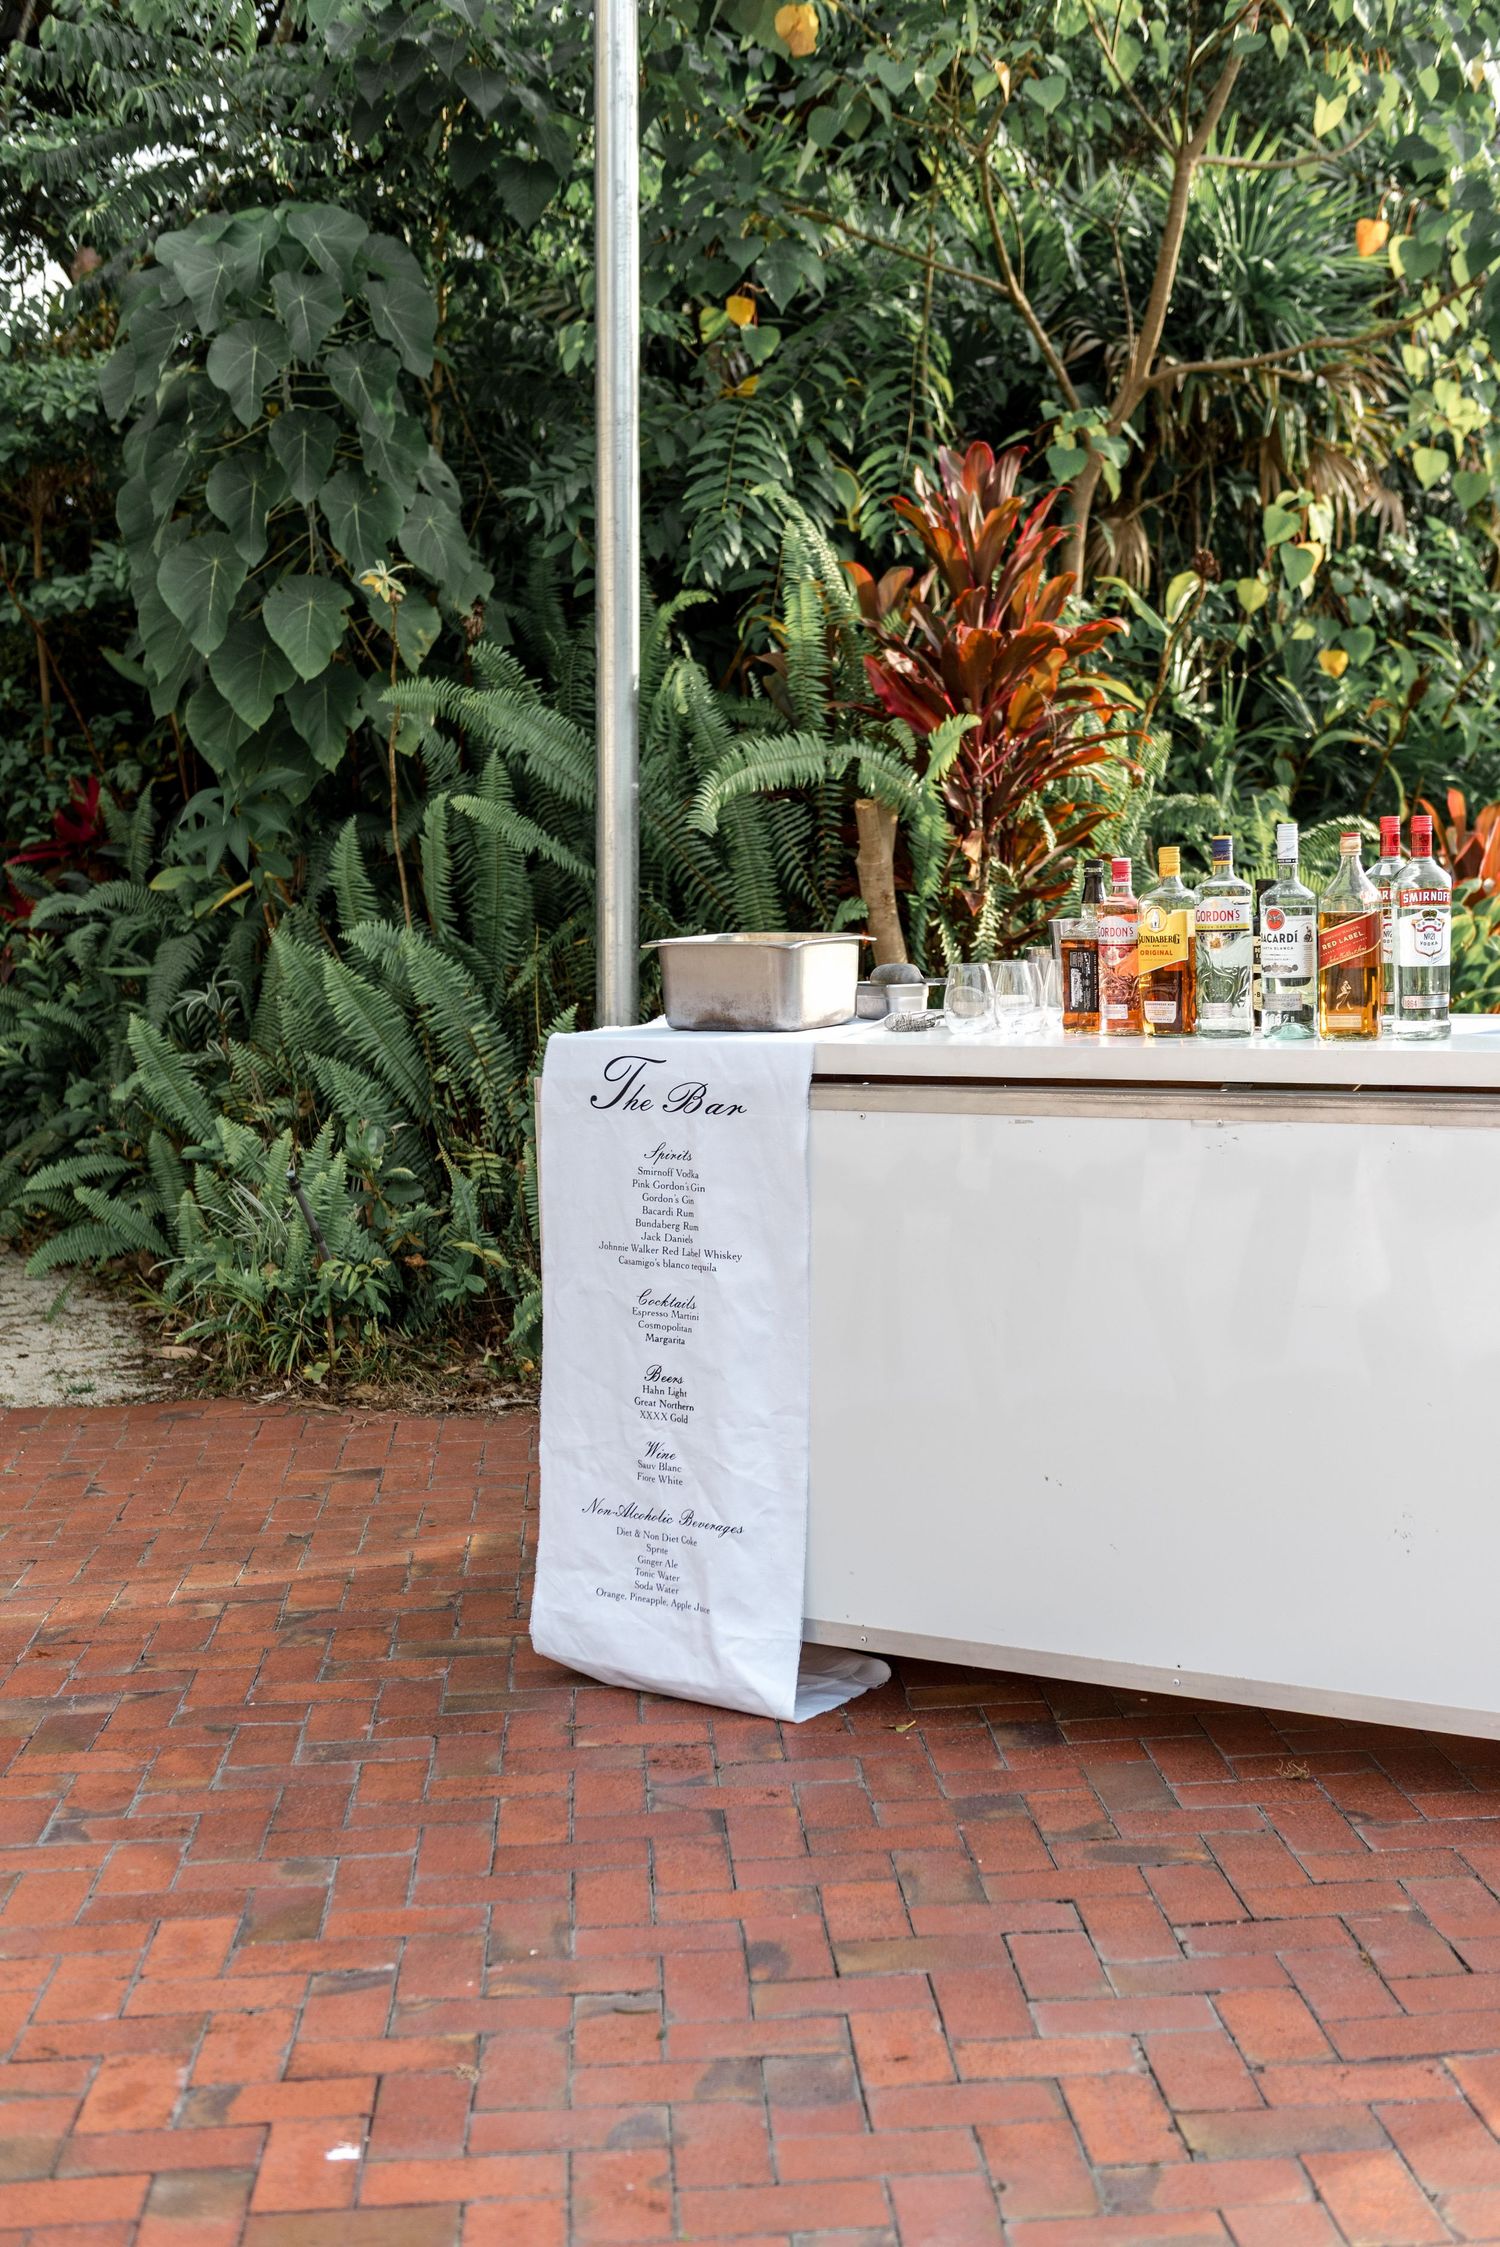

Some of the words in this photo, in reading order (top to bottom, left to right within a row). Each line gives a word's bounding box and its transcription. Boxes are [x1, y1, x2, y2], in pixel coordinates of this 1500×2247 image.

[1195, 909, 1240, 923] GORDON'S
[1322, 940, 1337, 950] RED
[1338, 931, 1364, 944] LABEL
[590, 1055, 667, 1111] The
[663, 1082, 747, 1116] Bar
[644, 1142, 693, 1165] Spirits
[637, 1167, 675, 1177] Smirnoff
[676, 1169, 699, 1179] Vodka
[632, 1180, 650, 1189] Pink
[652, 1180, 690, 1191] Gordon's
[691, 1183, 706, 1193] Gin
[642, 1193, 679, 1204] Gordon's
[681, 1195, 694, 1205] Gin
[642, 1206, 674, 1217] Bacardi
[676, 1208, 694, 1218] Rum
[635, 1219, 680, 1232] Bundaberg
[683, 1221, 699, 1232] Rum
[641, 1232, 661, 1242] Jack
[664, 1234, 694, 1244] Daniels
[598, 1241, 629, 1252] Johnnie
[631, 1244, 659, 1255] Walker
[662, 1246, 679, 1256] Red
[682, 1247, 701, 1258] Label
[704, 1249, 743, 1262] Whiskey
[618, 1256, 661, 1269] Casamigo's
[662, 1258, 690, 1270] blanco
[691, 1262, 717, 1273] tequila
[636, 1288, 697, 1310] Cocktails
[632, 1307, 669, 1318] Espresso
[671, 1310, 699, 1321] Martini
[638, 1320, 692, 1333] Cosmopolitan
[645, 1333, 685, 1346] Margarita
[644, 1364, 684, 1384] Beers
[642, 1385, 665, 1395] Hahn
[668, 1387, 687, 1398] Light
[634, 1397, 656, 1408] Great
[659, 1400, 695, 1412] Northern
[640, 1410, 668, 1421] XXXX
[670, 1413, 688, 1424] Gold
[643, 1440, 677, 1460] Wine
[637, 1460, 656, 1471] Sauv
[658, 1462, 682, 1473] Blanc
[637, 1472, 655, 1483] Fiore
[658, 1474, 683, 1486] White
[582, 1497, 674, 1525] Non-Alcoholic
[678, 1508, 744, 1538] Beverages
[616, 1527, 632, 1537] Diet
[634, 1529, 641, 1537] &
[643, 1531, 660, 1540] Non
[661, 1533, 678, 1543] Diet
[681, 1535, 697, 1546] Coke
[646, 1544, 668, 1557] Sprite
[637, 1555, 663, 1569] Ginger
[664, 1559, 678, 1568] Ale
[635, 1567, 655, 1578] Tonic
[657, 1570, 680, 1581] Water
[634, 1581, 654, 1591] Soda
[656, 1583, 679, 1595] Water
[596, 1587, 627, 1602] Orange,
[630, 1593, 669, 1607] Pineapple,
[671, 1598, 692, 1611] Apple
